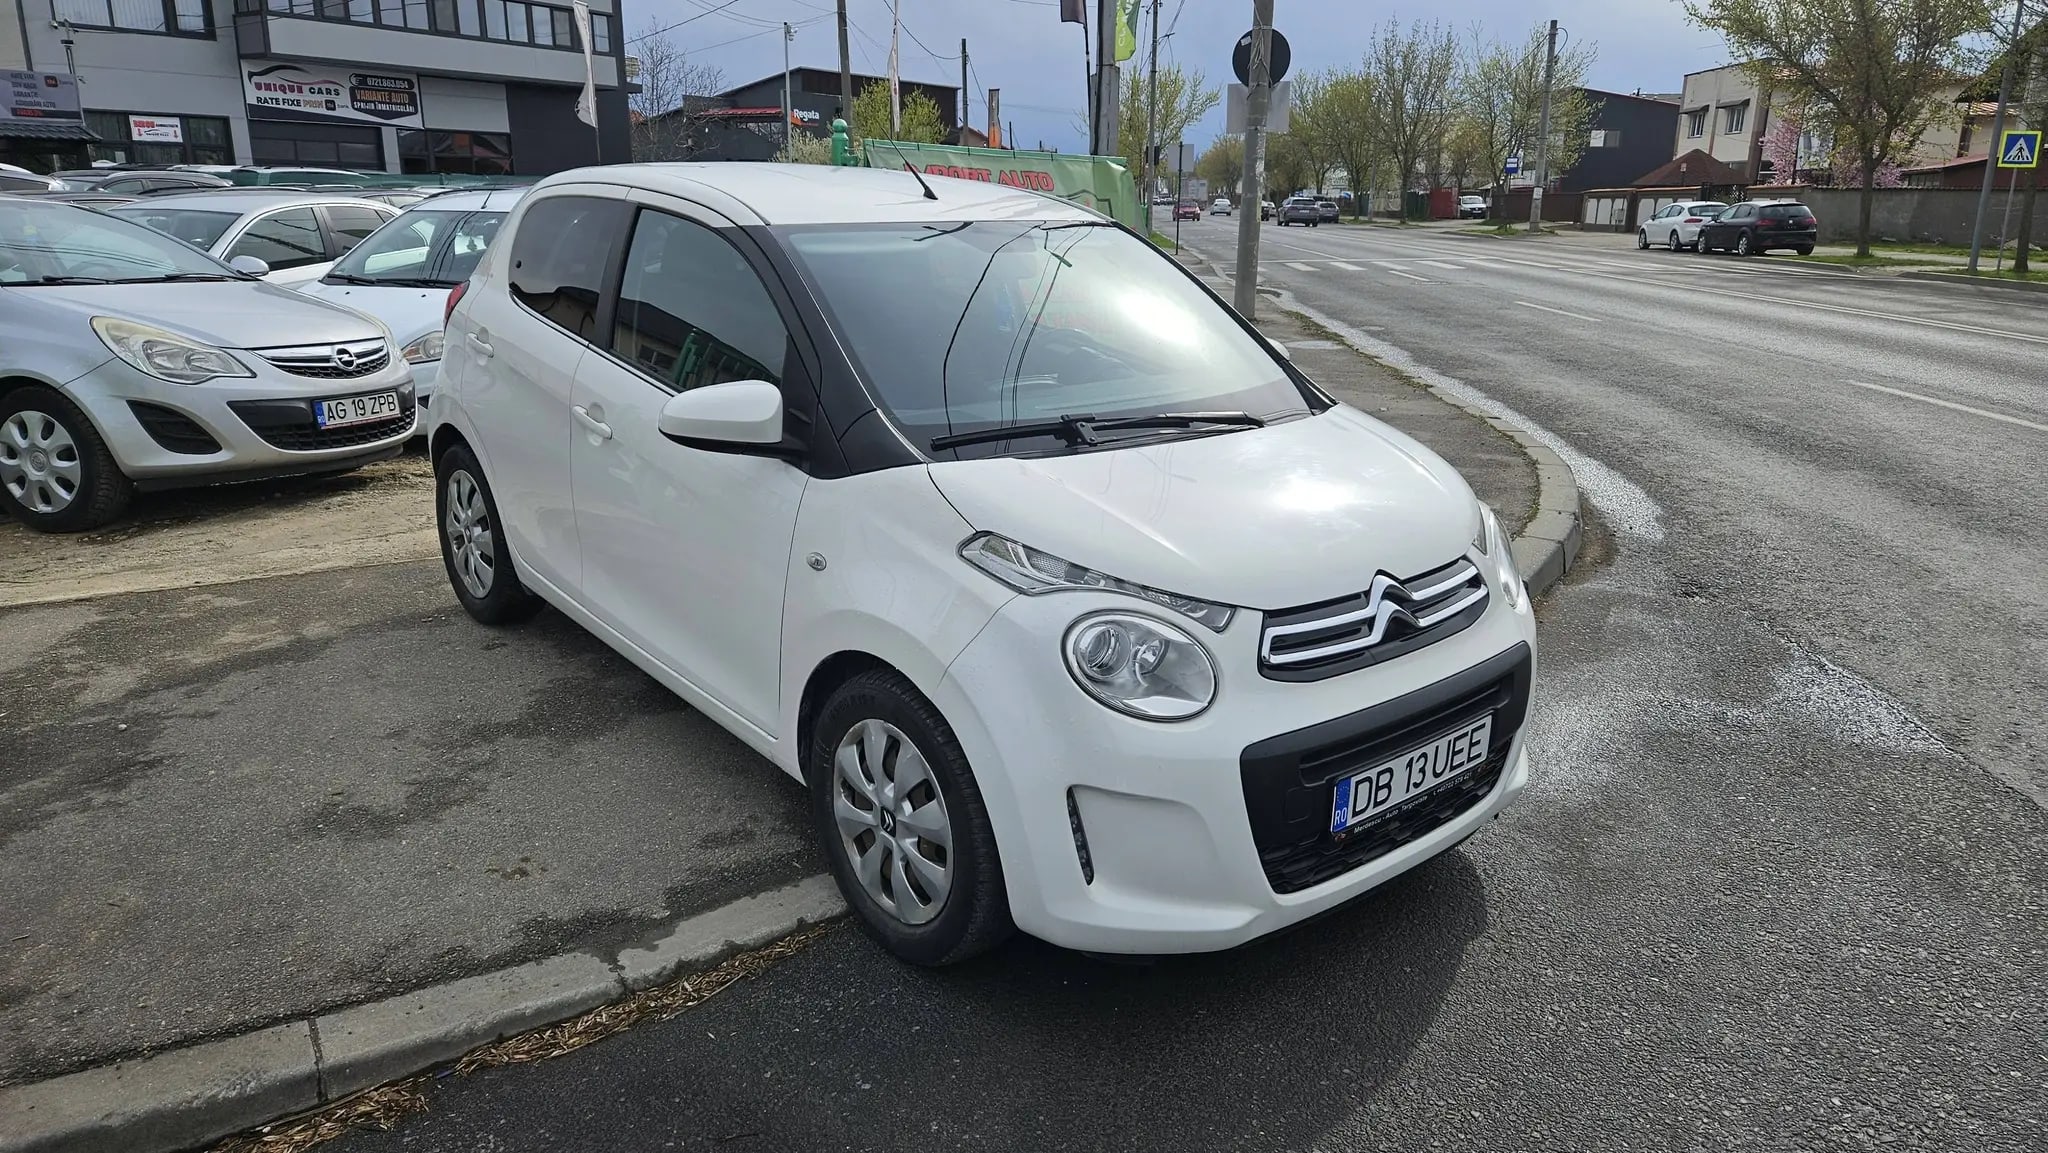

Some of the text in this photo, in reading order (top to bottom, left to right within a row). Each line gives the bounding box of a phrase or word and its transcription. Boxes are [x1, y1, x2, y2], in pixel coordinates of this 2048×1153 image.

[254, 82, 341, 96] UNIQUE CARS
[355, 89, 409, 103] VARIANTE AUTO
[256, 97, 324, 108] RATE FIXE PRIN
[793, 109, 820, 121] Regata
[999, 170, 1055, 191] AUTO
[327, 394, 396, 421] AG 19 ZPB
[317, 415, 325, 423] RO
[1352, 722, 1486, 819] DB 13 UEE
[1334, 807, 1348, 826] RO
[1385, 809, 1399, 819] Auto
